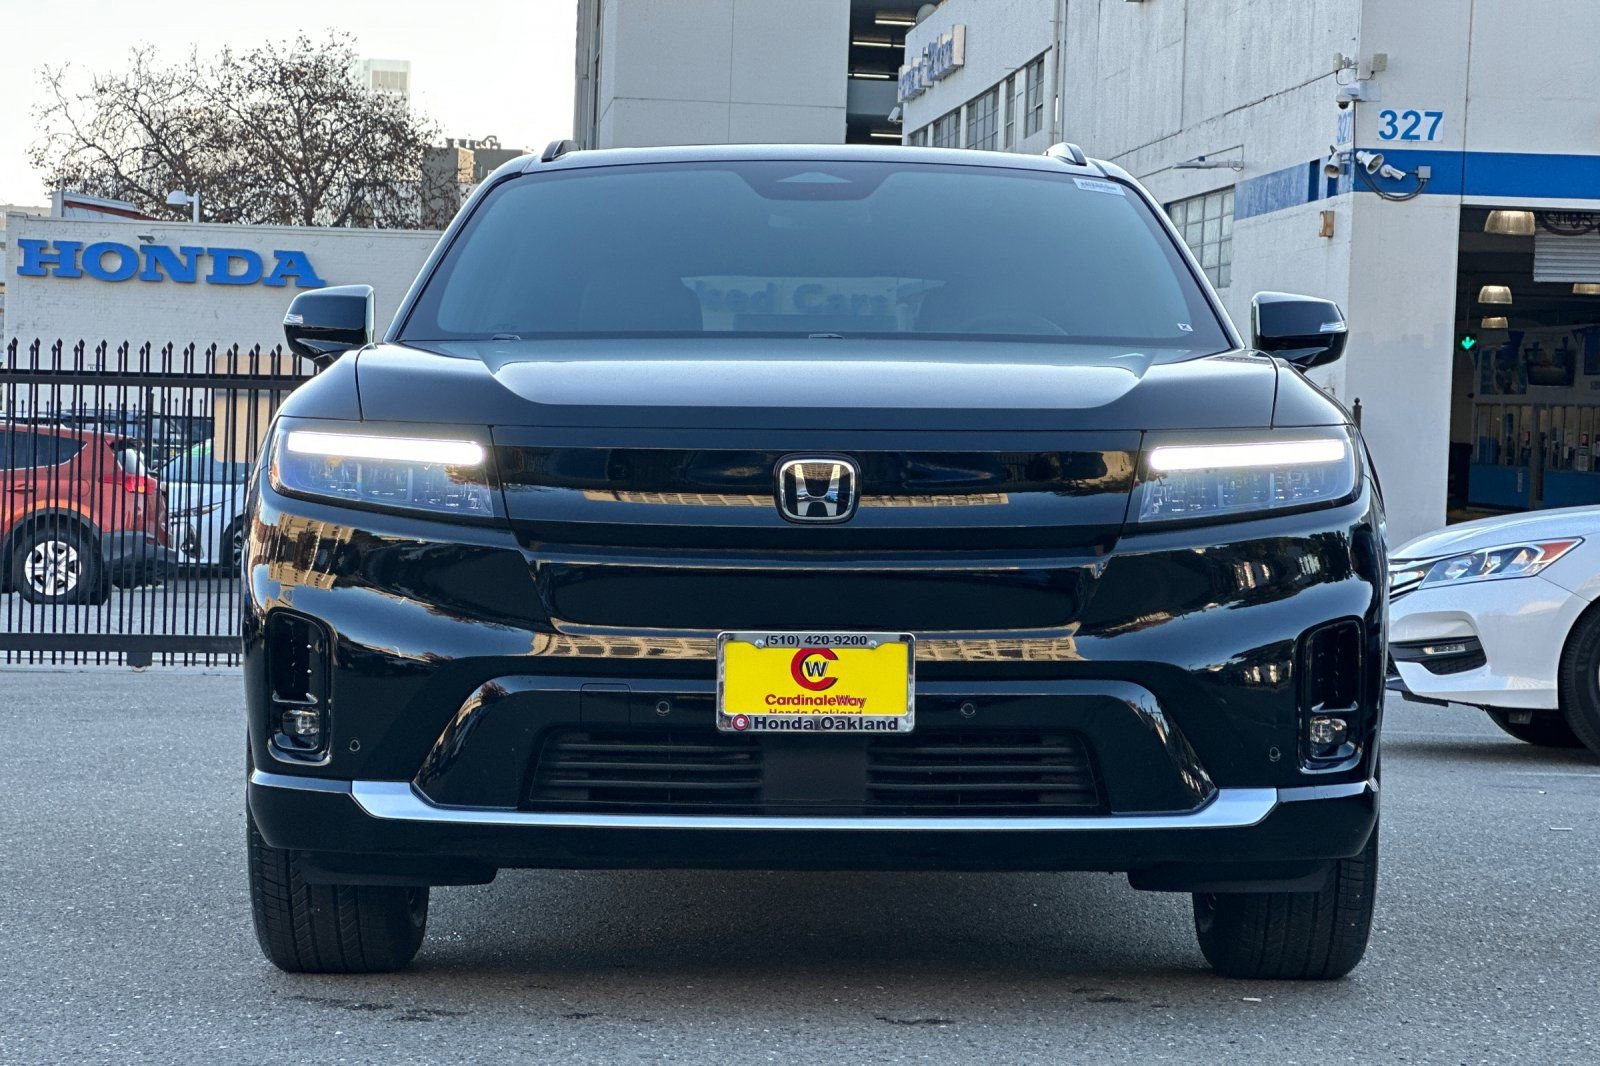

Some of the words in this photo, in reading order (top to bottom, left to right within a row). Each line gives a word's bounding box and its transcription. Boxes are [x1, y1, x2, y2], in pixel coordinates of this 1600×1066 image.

[1378, 109, 1443, 141] 327
[17, 238, 326, 288] HONDA
[765, 635, 800, 648] (510)
[804, 635, 867, 646] 420-9200
[765, 694, 867, 709] CardinaleWay
[754, 716, 814, 731] Honda
[820, 716, 899, 731] Oakland
